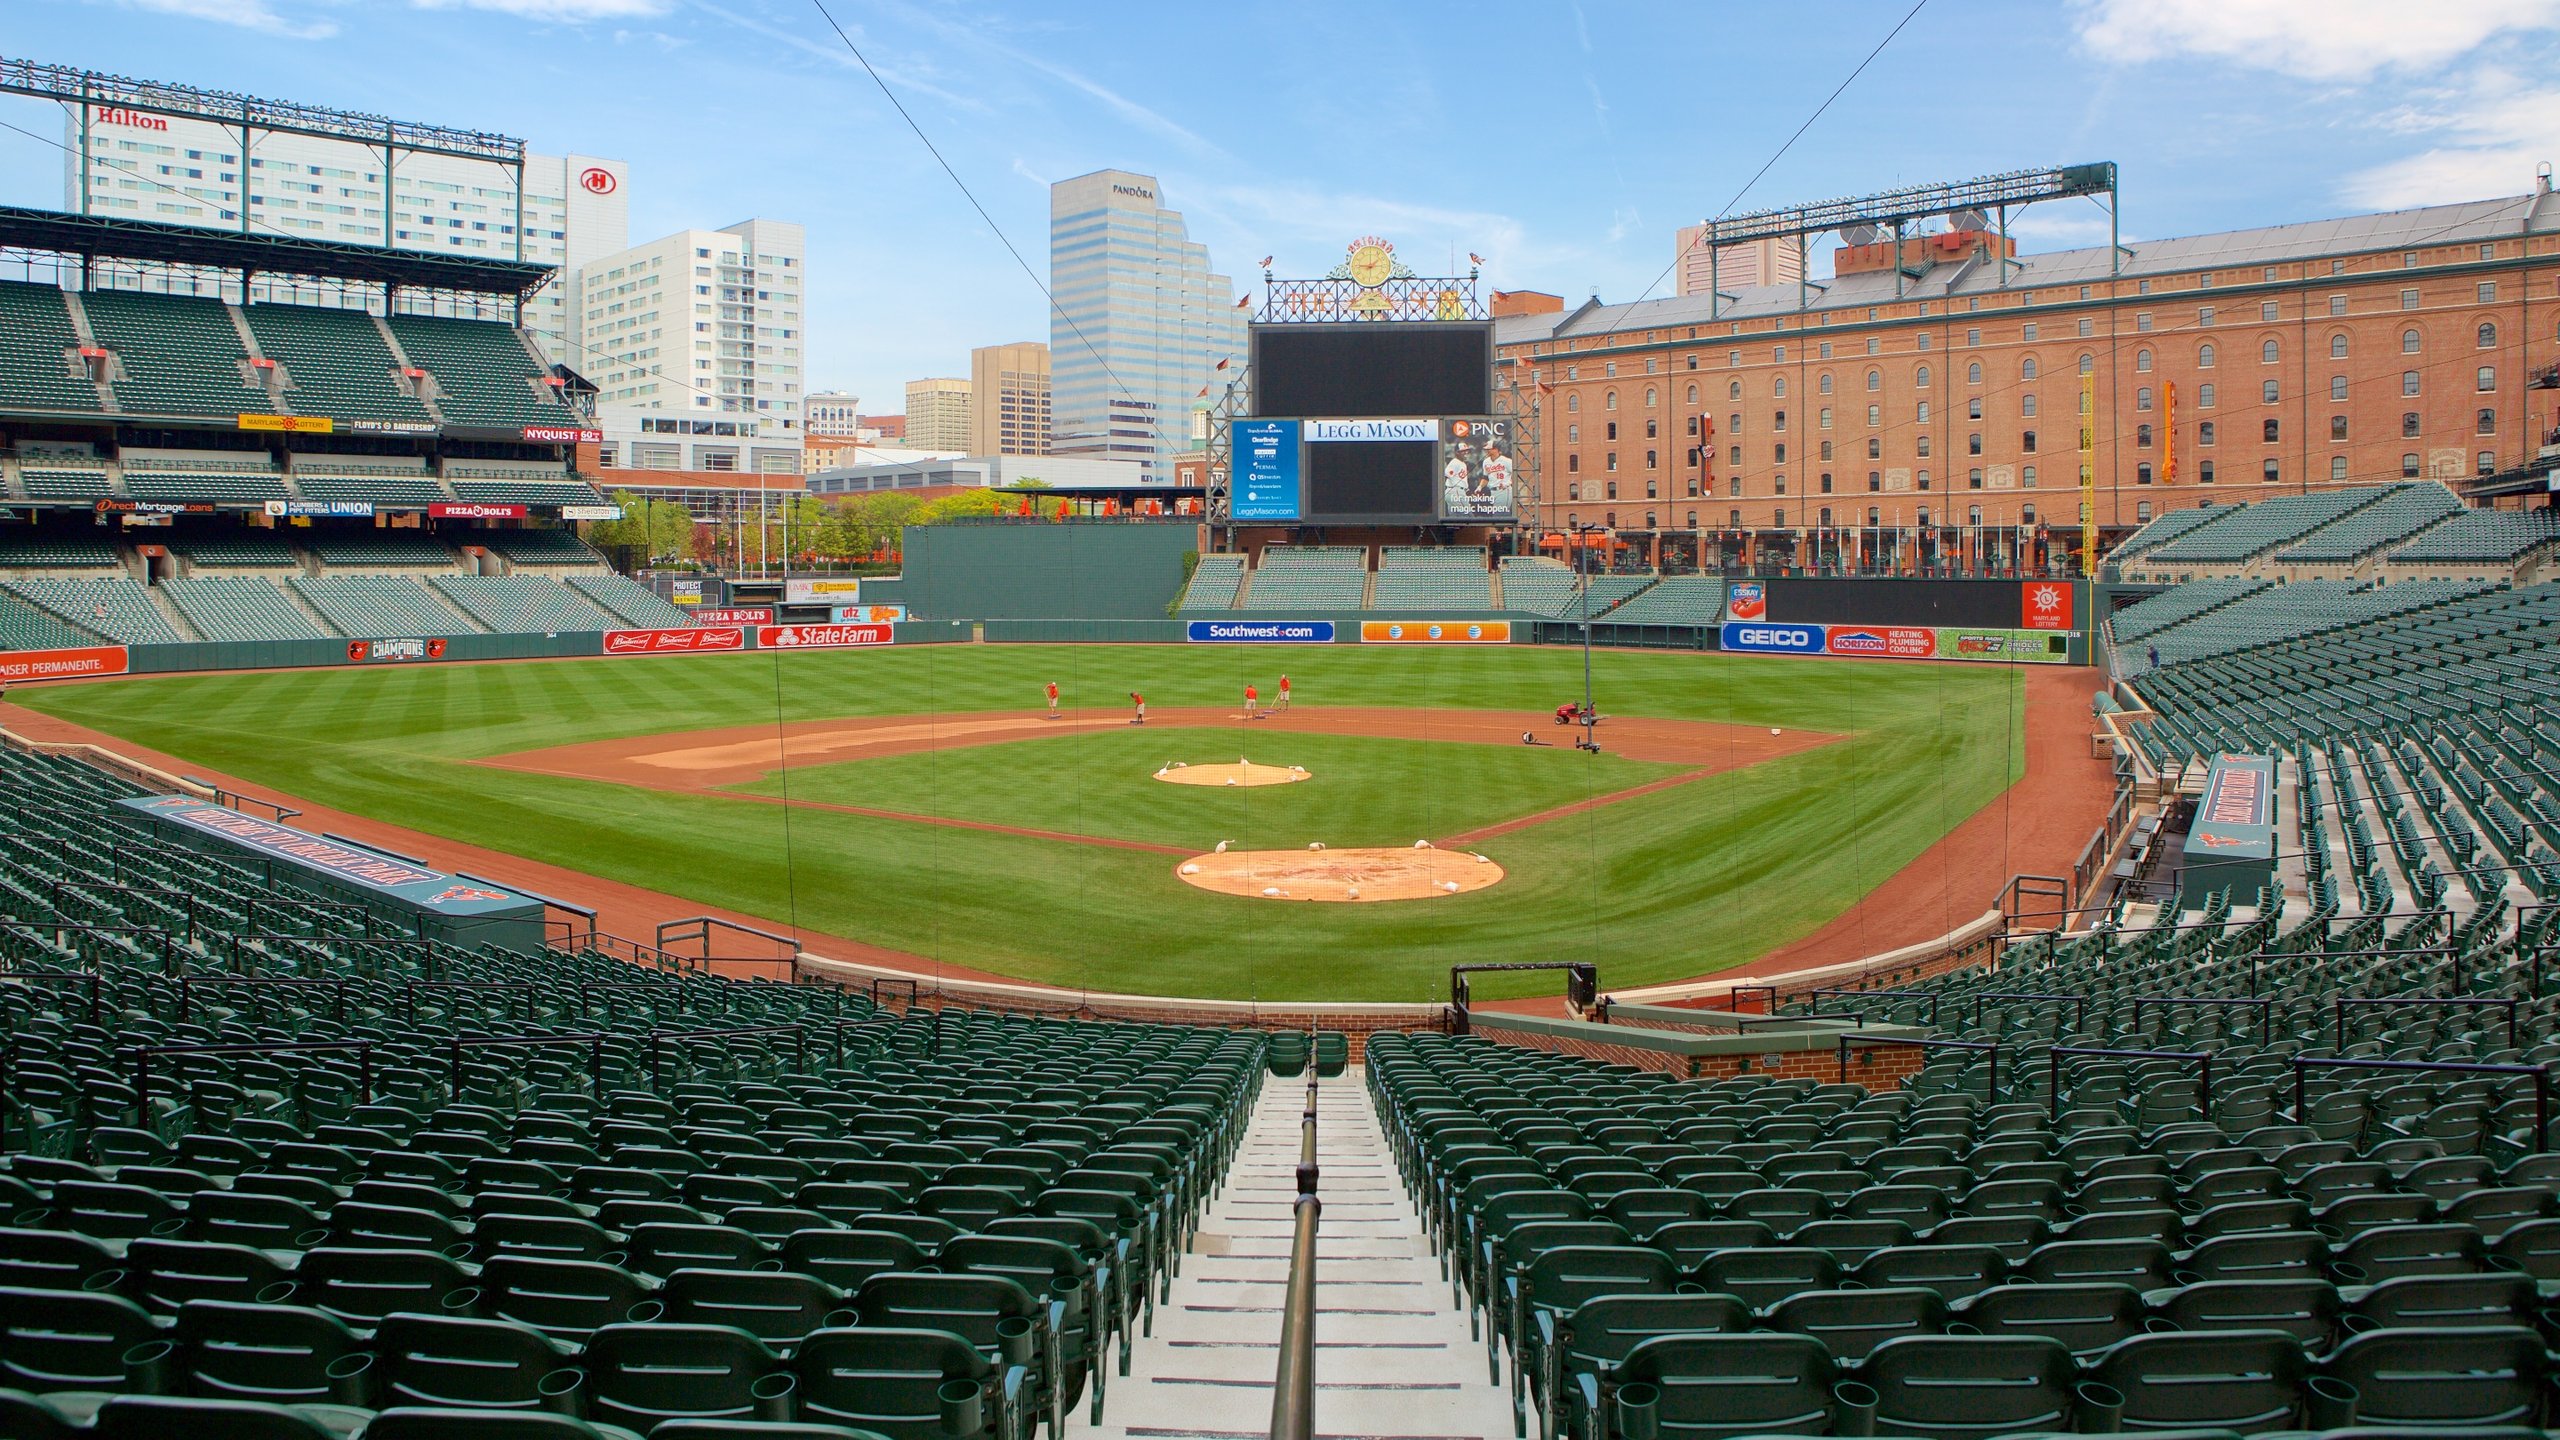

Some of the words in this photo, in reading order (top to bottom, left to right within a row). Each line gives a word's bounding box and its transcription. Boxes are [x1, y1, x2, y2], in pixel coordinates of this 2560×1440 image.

[97, 107, 168, 131] Hilton
[1113, 184, 1153, 199] PANDORA
[247, 418, 281, 426] MARYLAND
[297, 421, 325, 429] LOTTERY
[354, 420, 382, 429] FLOYD'S
[393, 423, 436, 432] BARBERSHOP
[1471, 422, 1504, 435] PNC
[527, 429, 574, 440] NYQUIST
[581, 430, 592, 438] 60
[1317, 423, 1361, 438] LEGG
[1366, 423, 1426, 438] MASON
[1451, 494, 1461, 502] for
[1464, 493, 1495, 504] making
[331, 502, 372, 513] UNION
[445, 507, 473, 516] PIZZA
[577, 507, 610, 515] Sheraton
[1236, 508, 1294, 516] LeggMason.com
[1450, 504, 1475, 514] magic
[1477, 503, 1510, 514] happen.
[673, 581, 703, 589] PROTECT
[1733, 589, 1759, 597] ESSKAY
[698, 611, 729, 621] PIZZA
[733, 610, 765, 621] BOLI'S
[842, 607, 859, 618] utz
[702, 633, 735, 643] Budweiser
[1739, 628, 1809, 647] GEICO
[1888, 630, 1923, 638] HEATING
[615, 637, 649, 646] Budweiser
[660, 635, 692, 645] Budweiser
[1834, 639, 1884, 649] HORIZON
[1888, 638, 1929, 646] PLUMBING
[372, 641, 424, 658] CHAMPIONS
[1888, 645, 1924, 654] COOLING
[32, 659, 100, 674] PERMANENTE
[181, 809, 280, 837] WELCOME
[250, 832, 303, 845] TO
[341, 862, 431, 885] PARK
